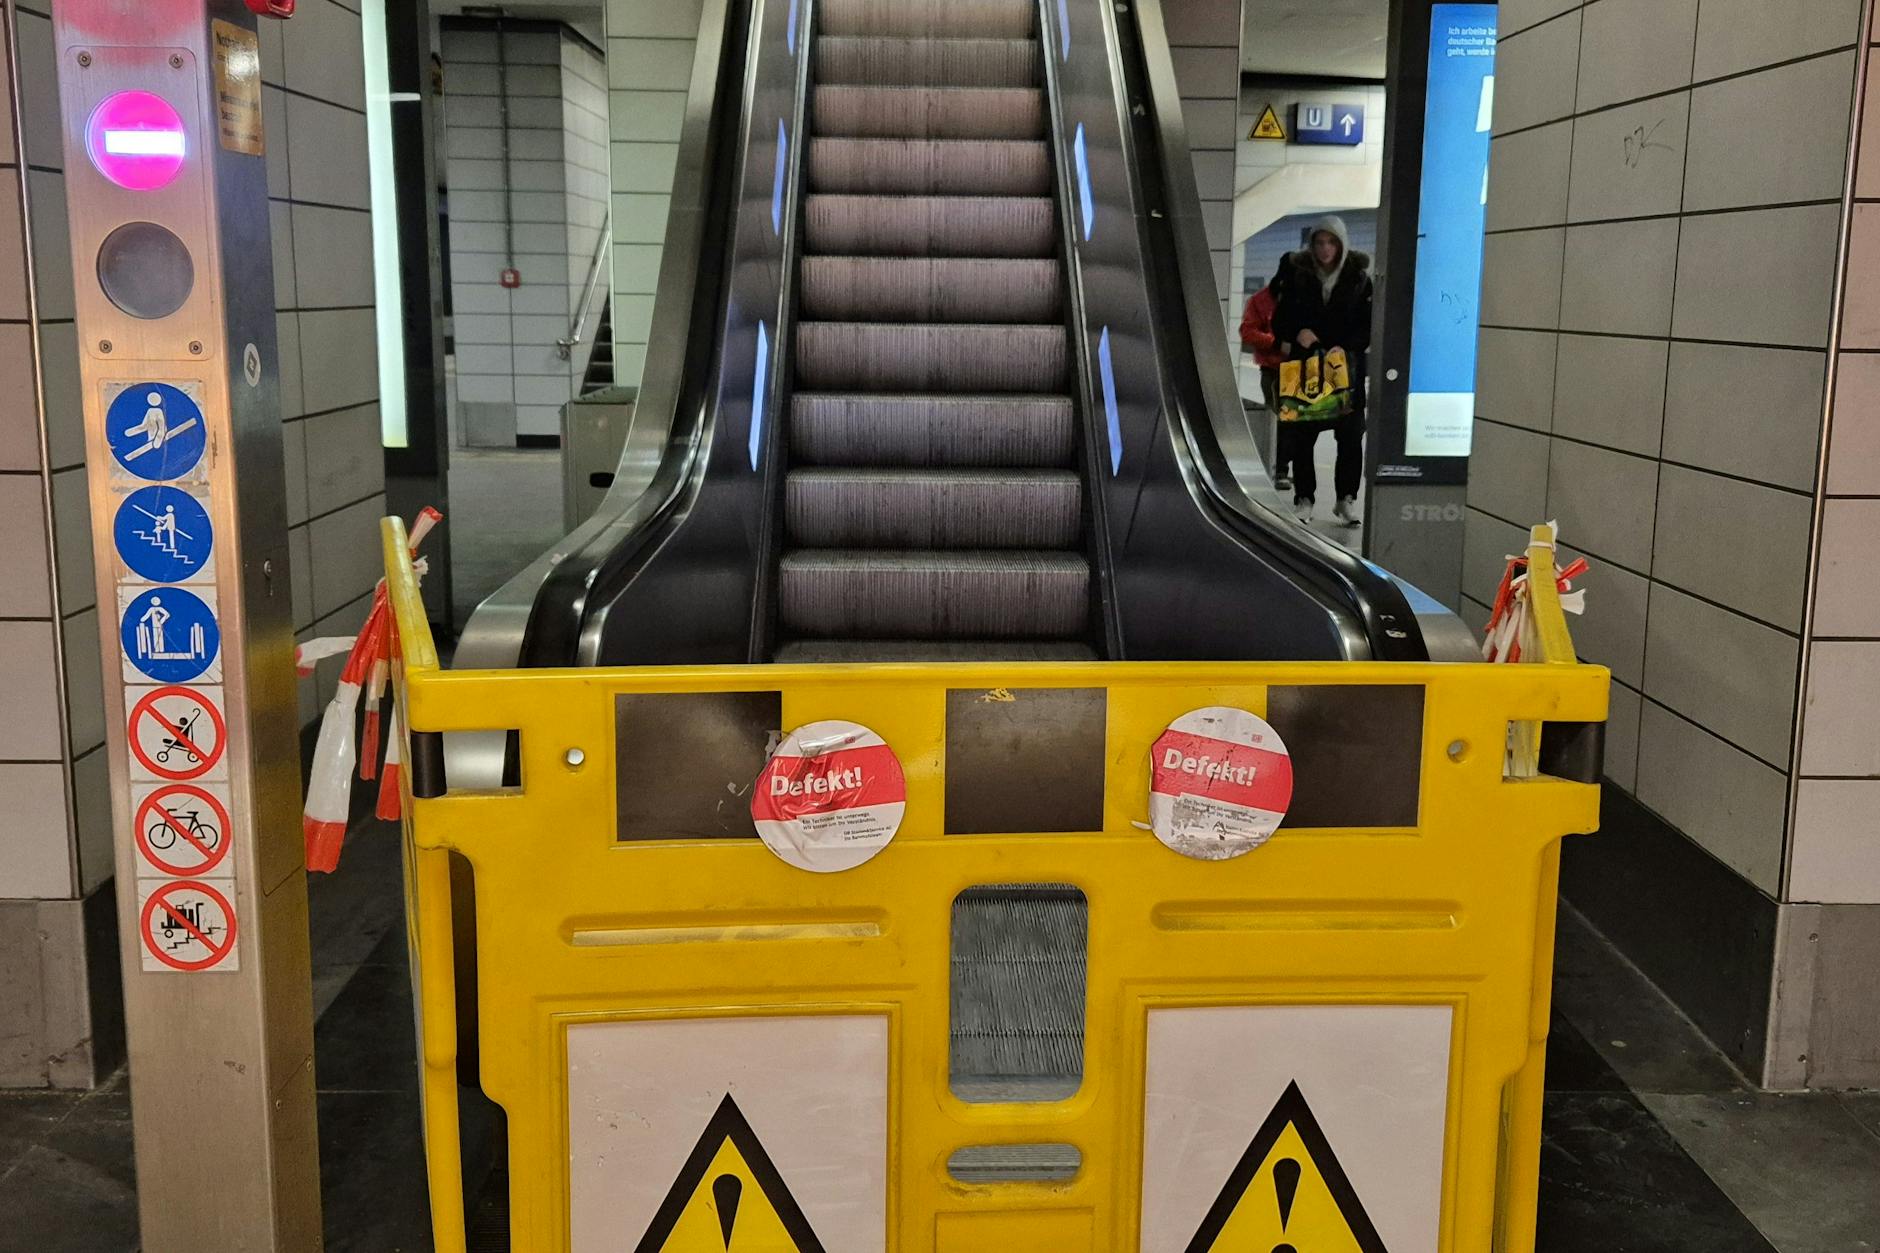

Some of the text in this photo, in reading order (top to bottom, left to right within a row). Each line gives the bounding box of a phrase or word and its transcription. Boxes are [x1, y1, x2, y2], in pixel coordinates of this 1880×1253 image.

[1309, 108, 1321, 126] U
[770, 766, 863, 796] Defekt!
[1162, 747, 1257, 787] Defekt!
